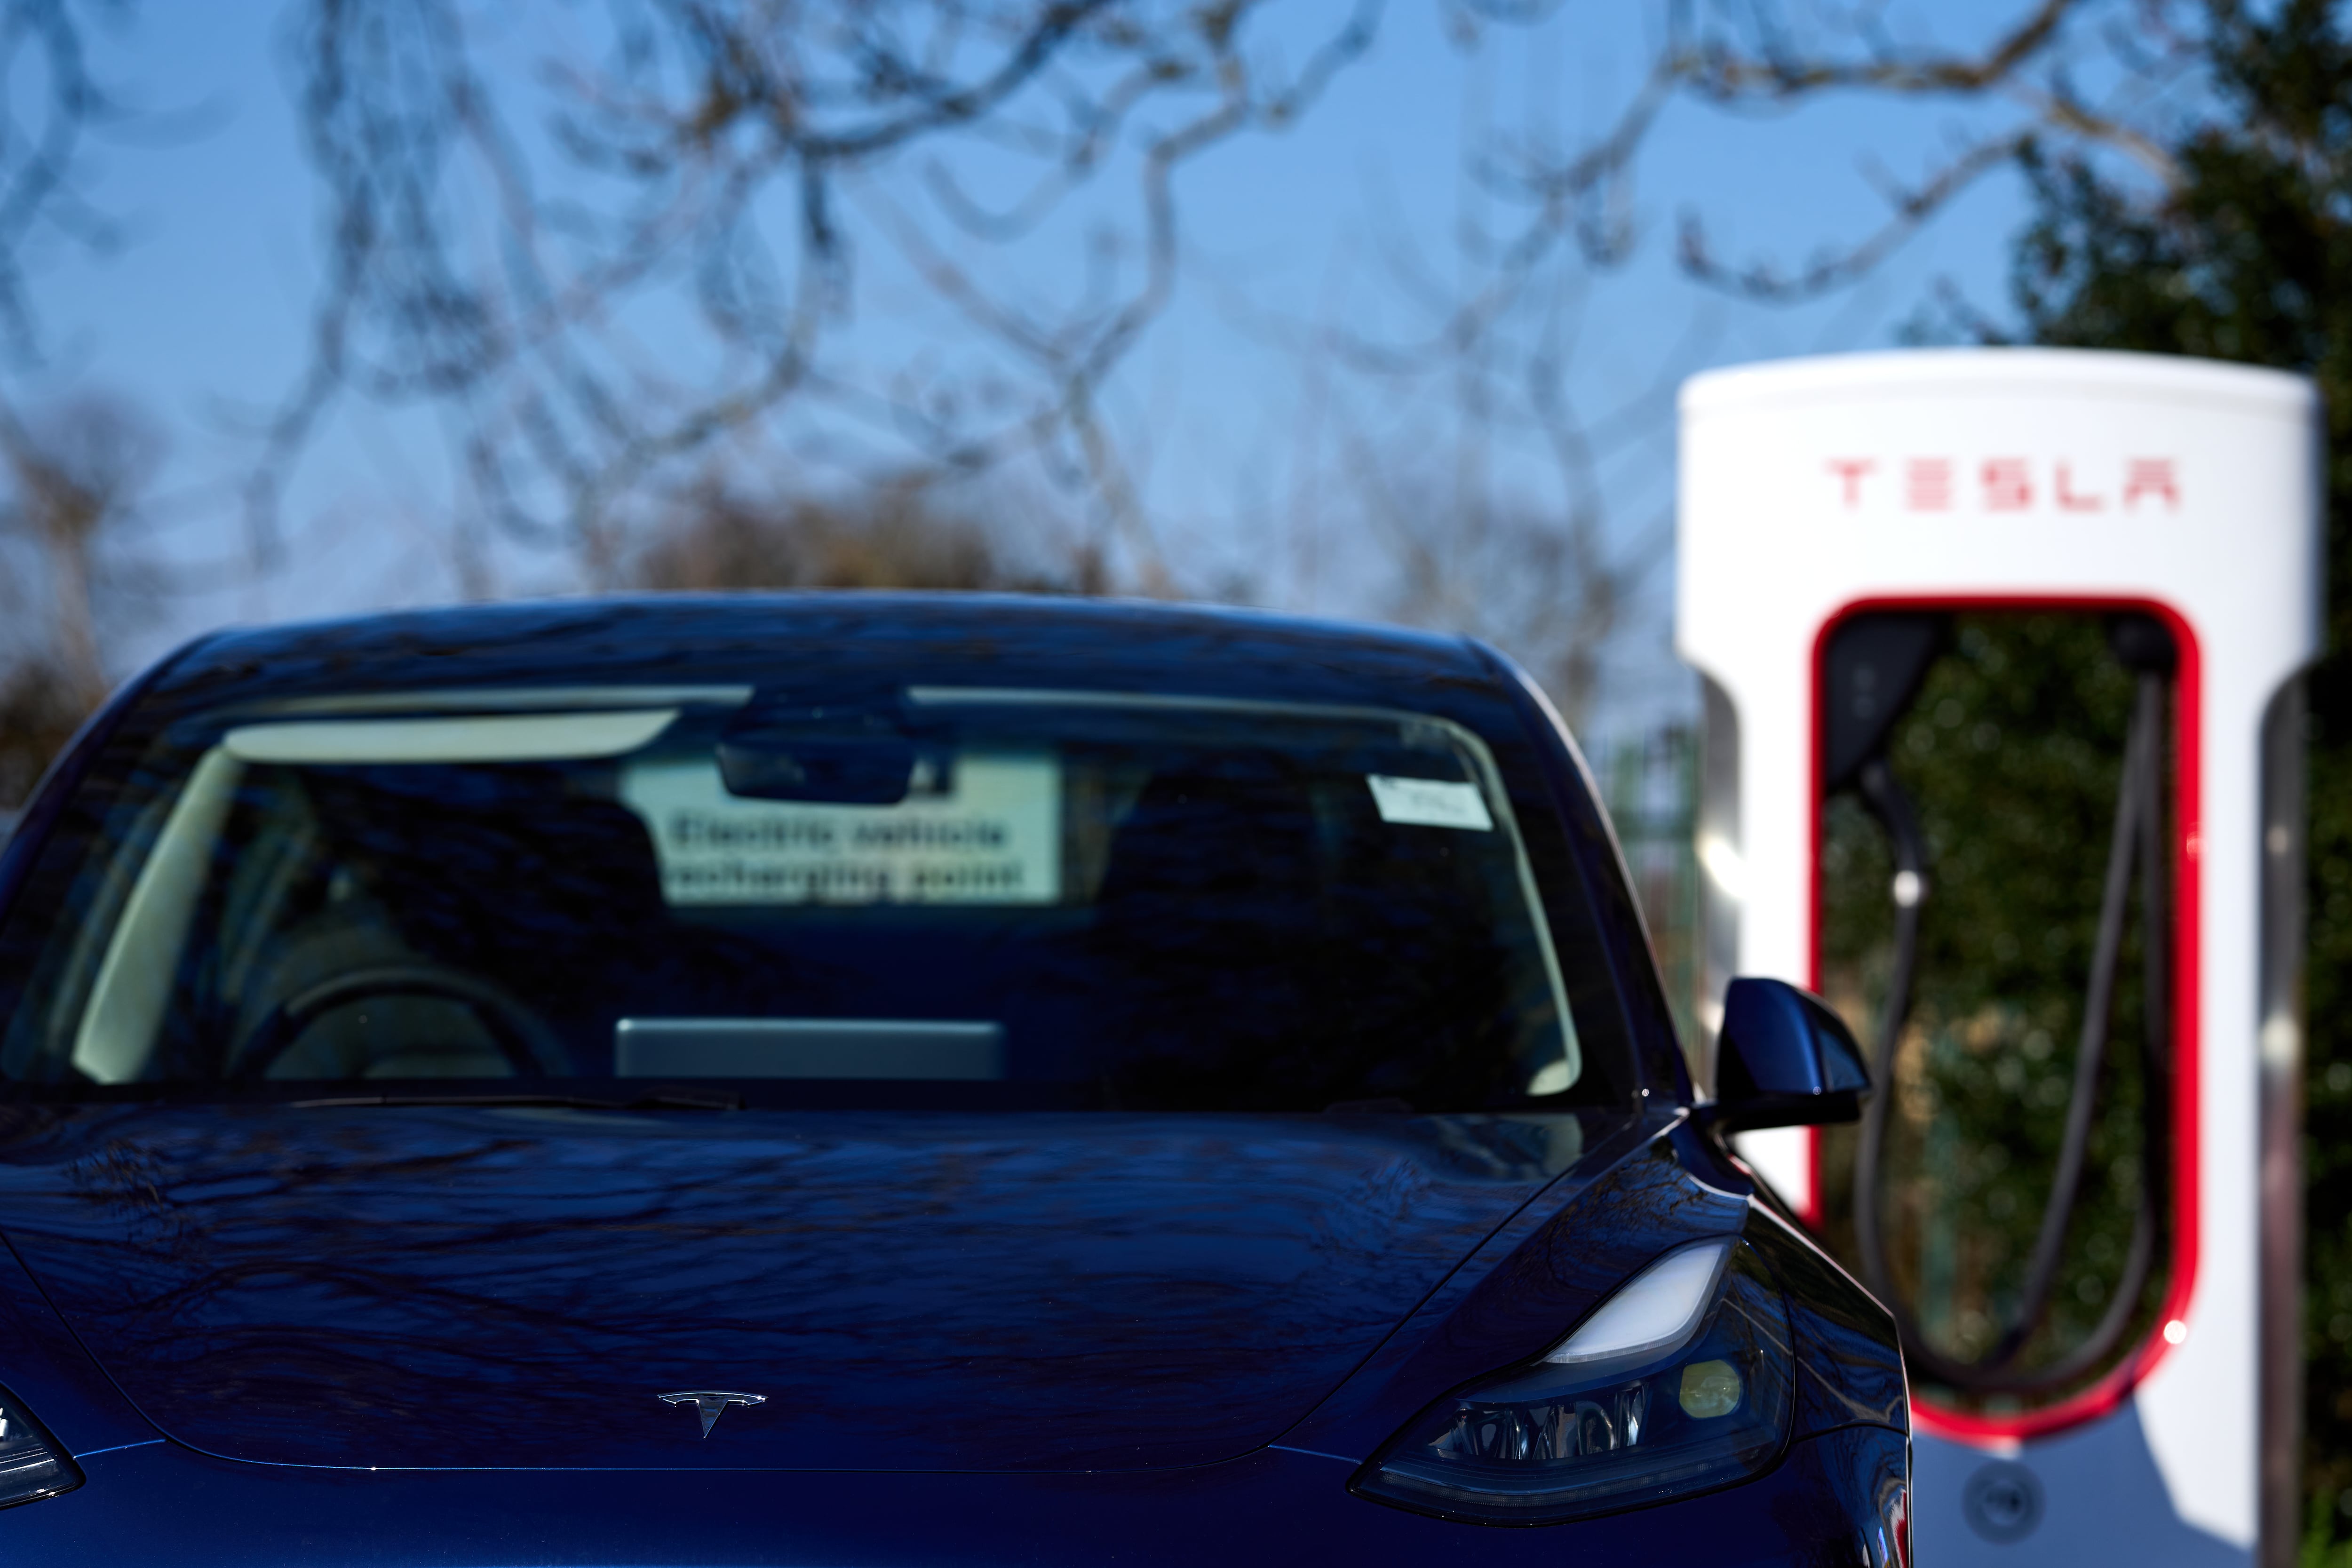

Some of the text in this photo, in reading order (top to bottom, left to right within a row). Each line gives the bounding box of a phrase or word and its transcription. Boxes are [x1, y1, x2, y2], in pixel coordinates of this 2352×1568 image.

[1825, 456, 2181, 512] TESLA
[672, 814, 1009, 850] Electric vehicle
[912, 861, 1020, 900] point
